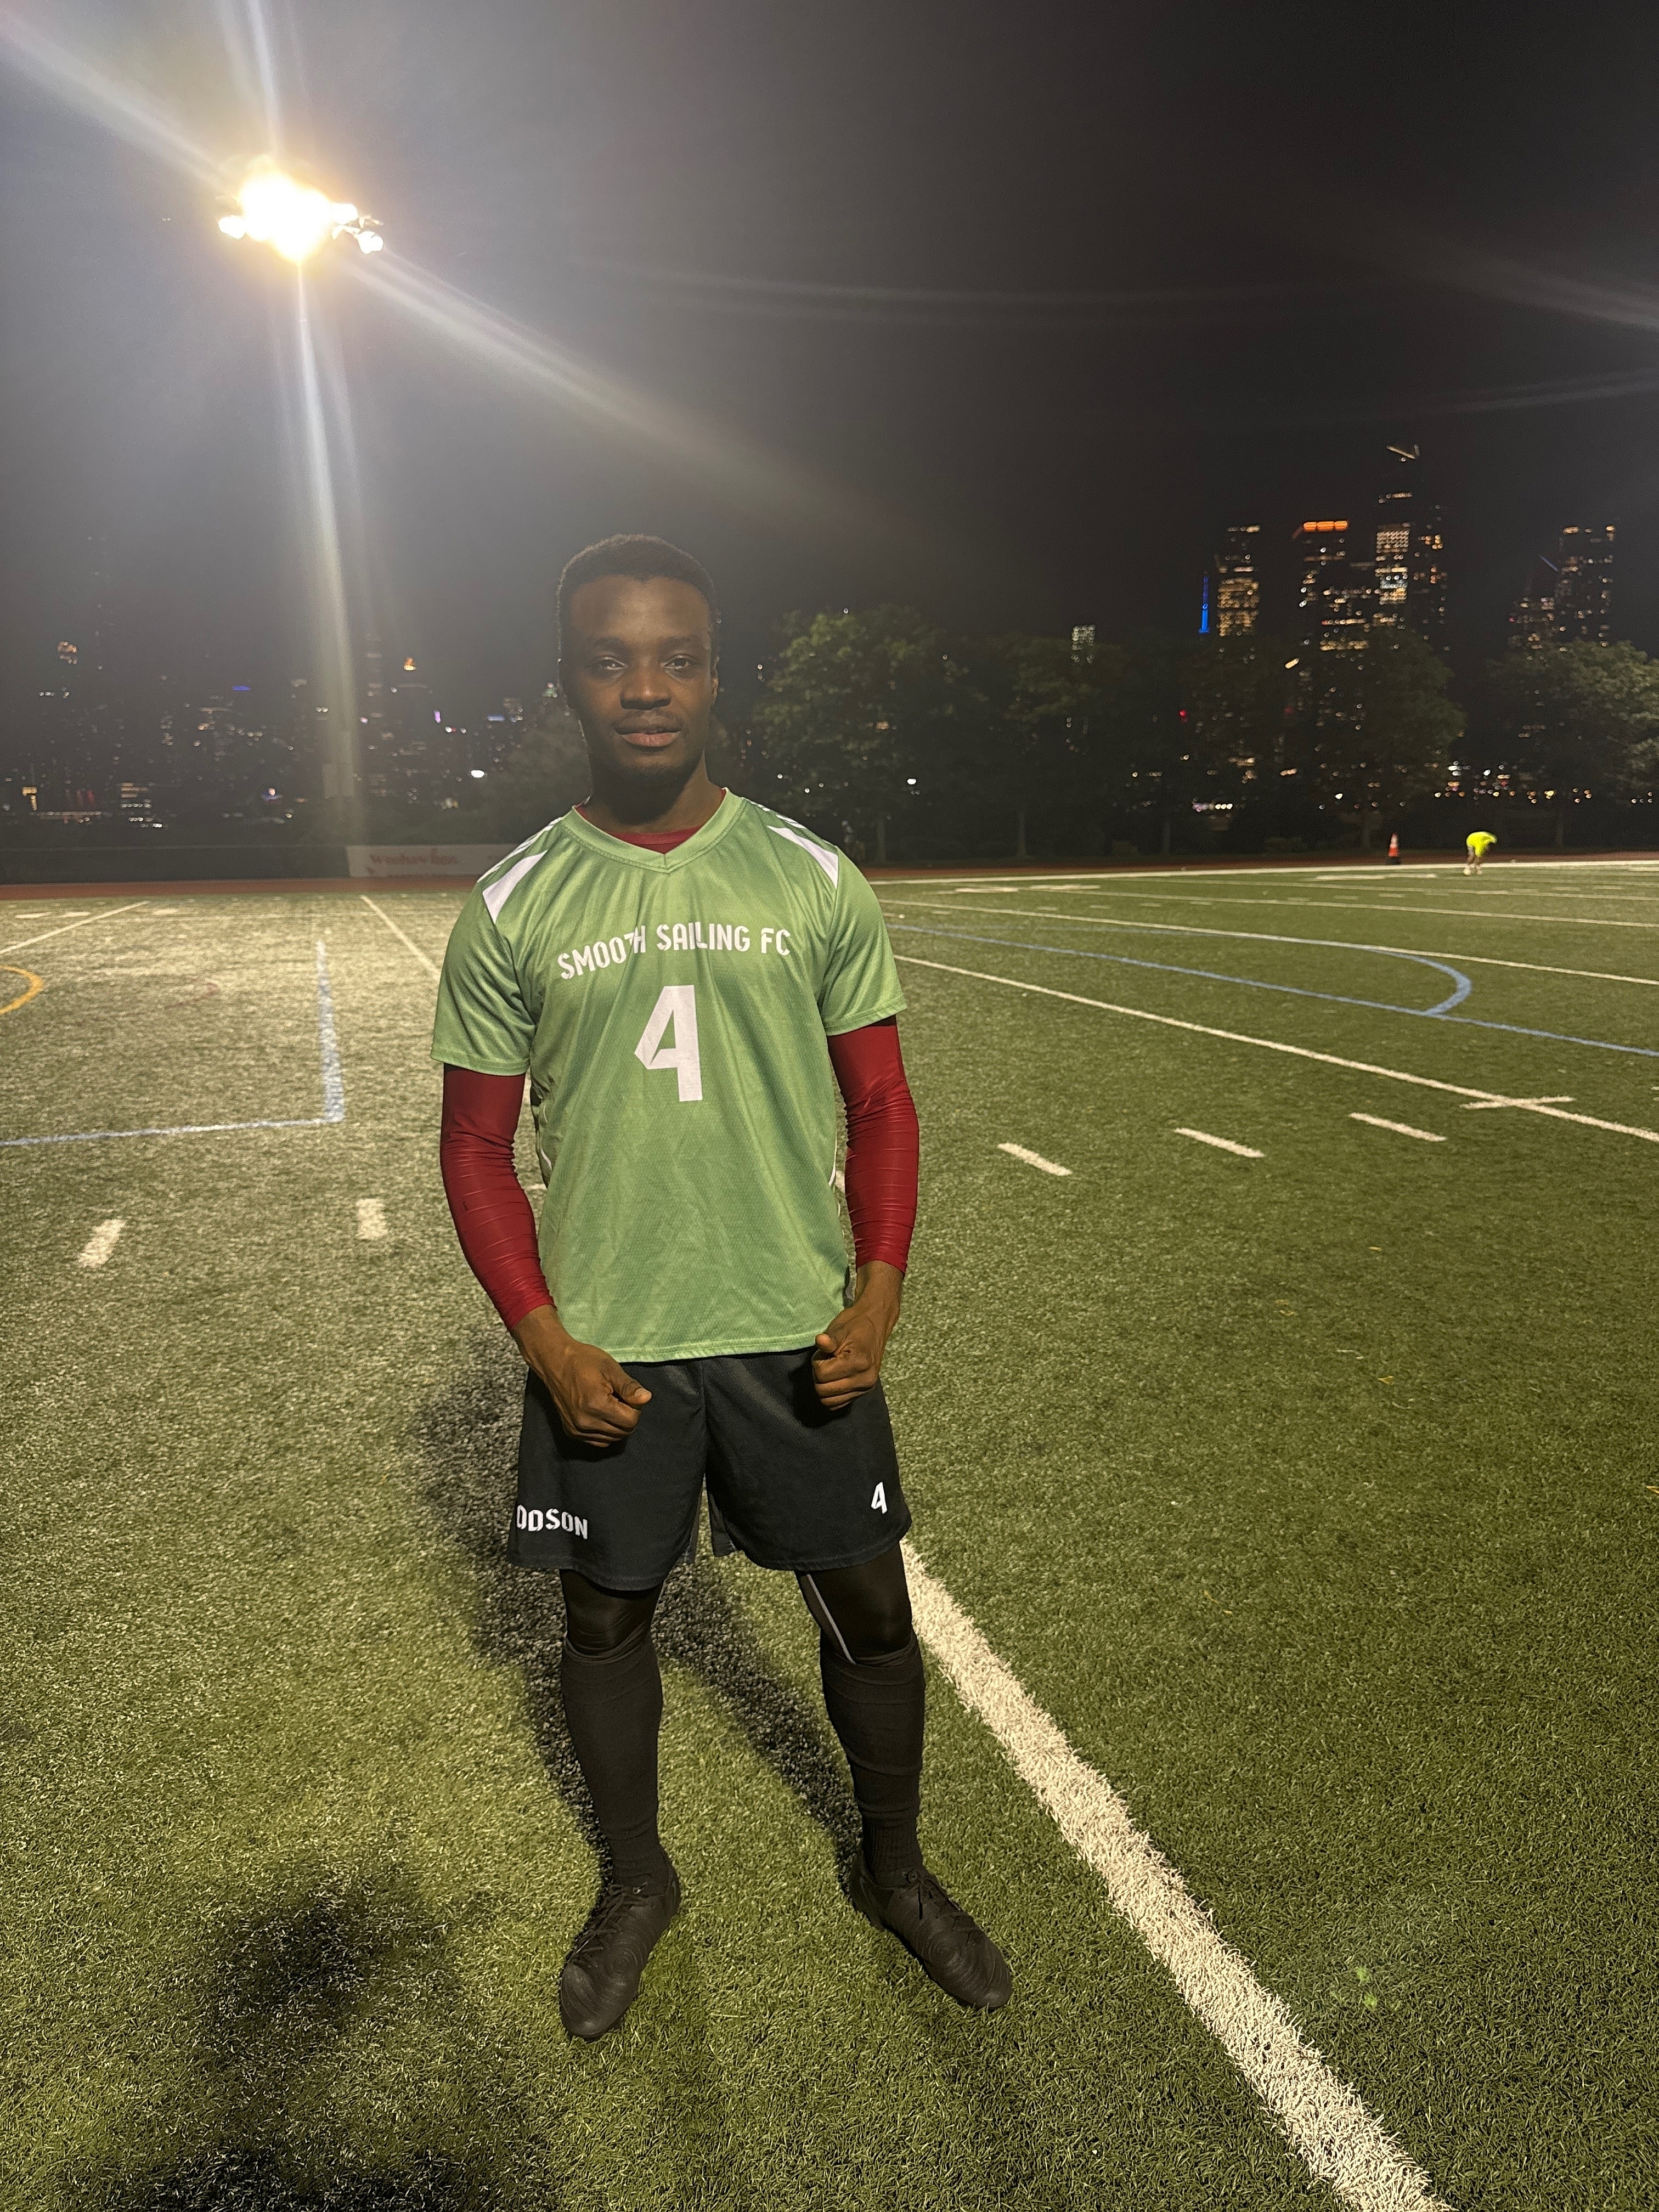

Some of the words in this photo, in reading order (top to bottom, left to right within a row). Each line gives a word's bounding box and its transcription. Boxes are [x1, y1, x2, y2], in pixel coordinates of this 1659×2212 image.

[657, 922, 750, 951] SAILING
[761, 928, 791, 956] FC
[634, 985, 703, 1102] 4
[871, 1481, 888, 1514] 4
